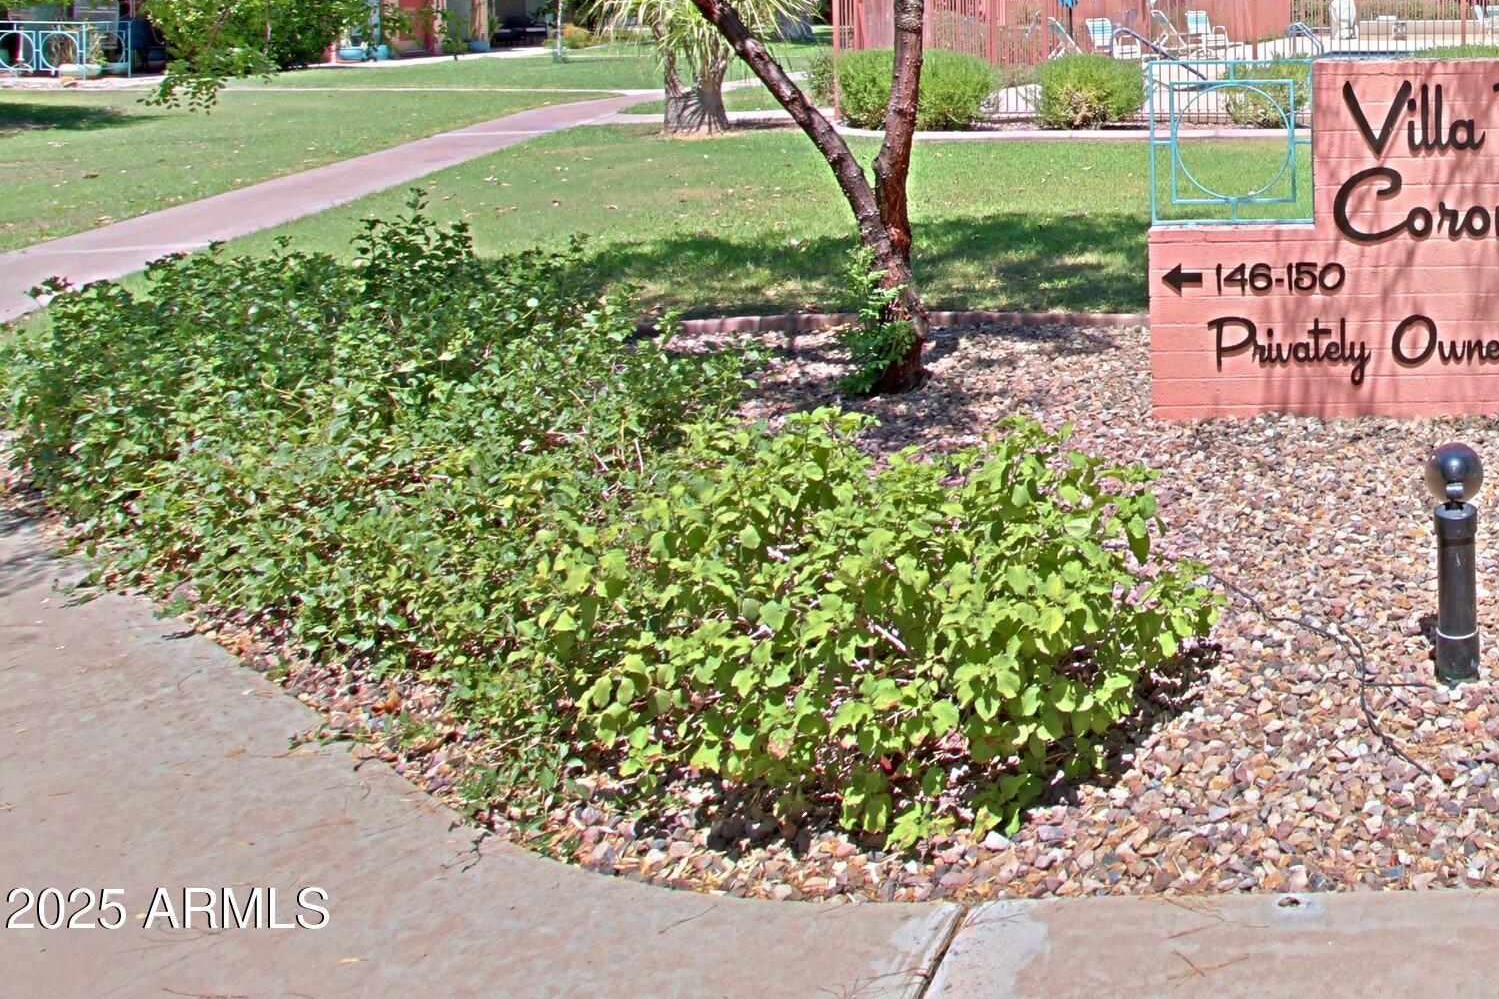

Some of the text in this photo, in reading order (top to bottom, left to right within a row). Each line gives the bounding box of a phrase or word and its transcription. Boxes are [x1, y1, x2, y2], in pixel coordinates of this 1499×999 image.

[1342, 80, 1485, 155] Villa
[1215, 262, 1345, 292] 146-150
[1207, 317, 1371, 386] Privately
